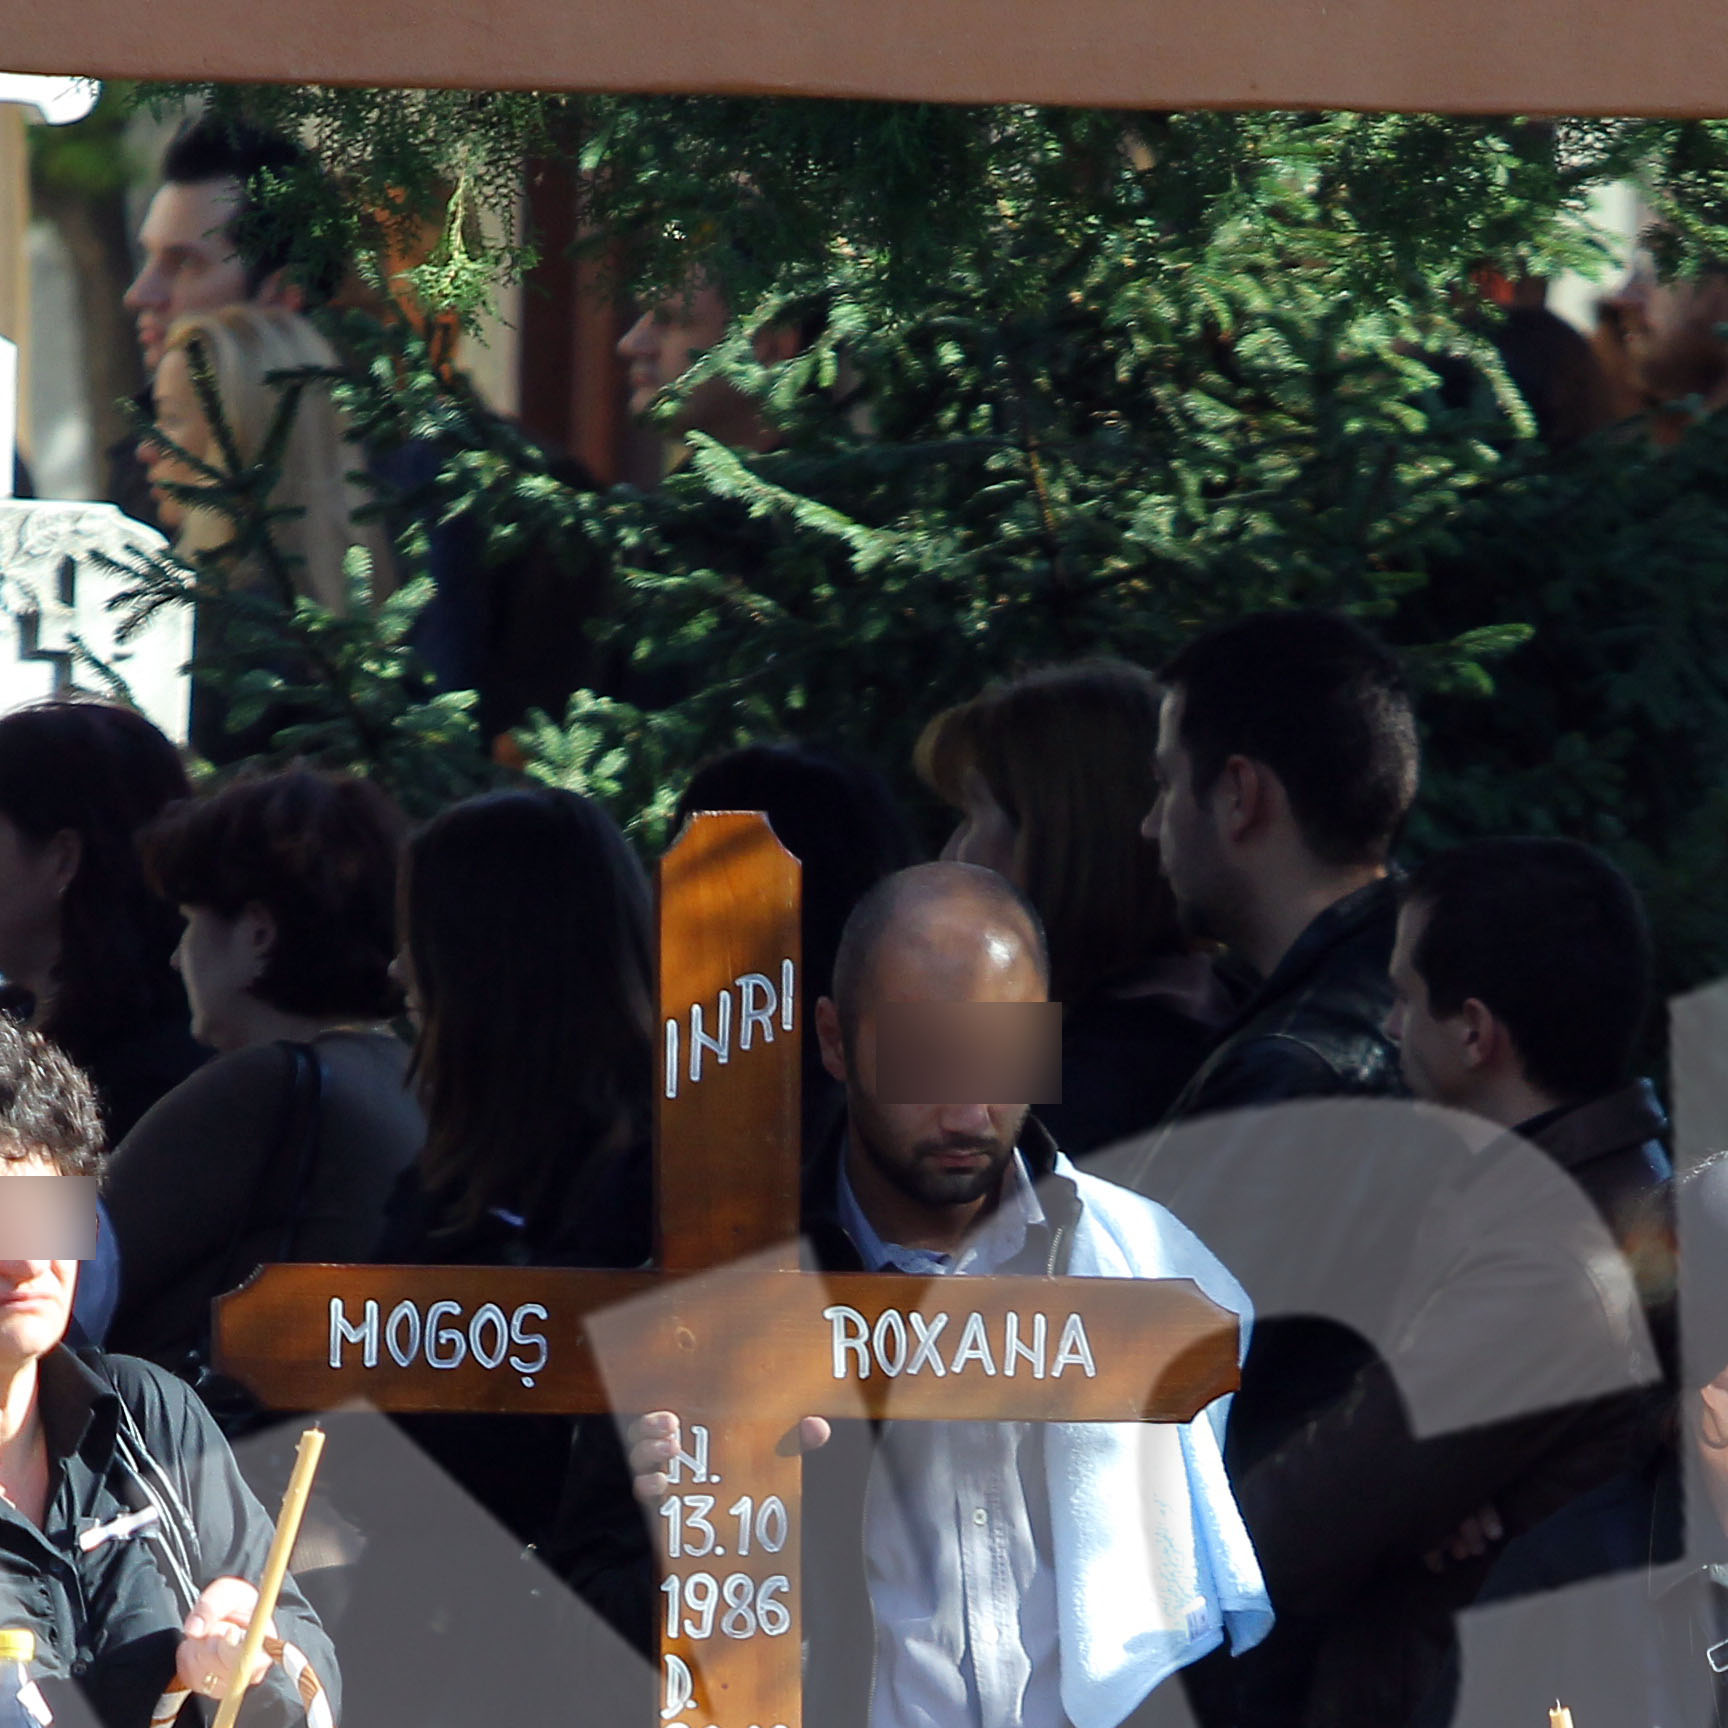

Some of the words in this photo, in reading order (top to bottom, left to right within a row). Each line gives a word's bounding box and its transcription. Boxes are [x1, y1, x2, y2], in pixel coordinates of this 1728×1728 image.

[663, 959, 795, 1099] INRI
[823, 1308, 1097, 1379] ROXANA
[666, 1425, 722, 1484] N.
[659, 1495, 789, 1558] 13.10
[659, 1572, 791, 1640] 1986
[660, 1654, 699, 1719] D.
